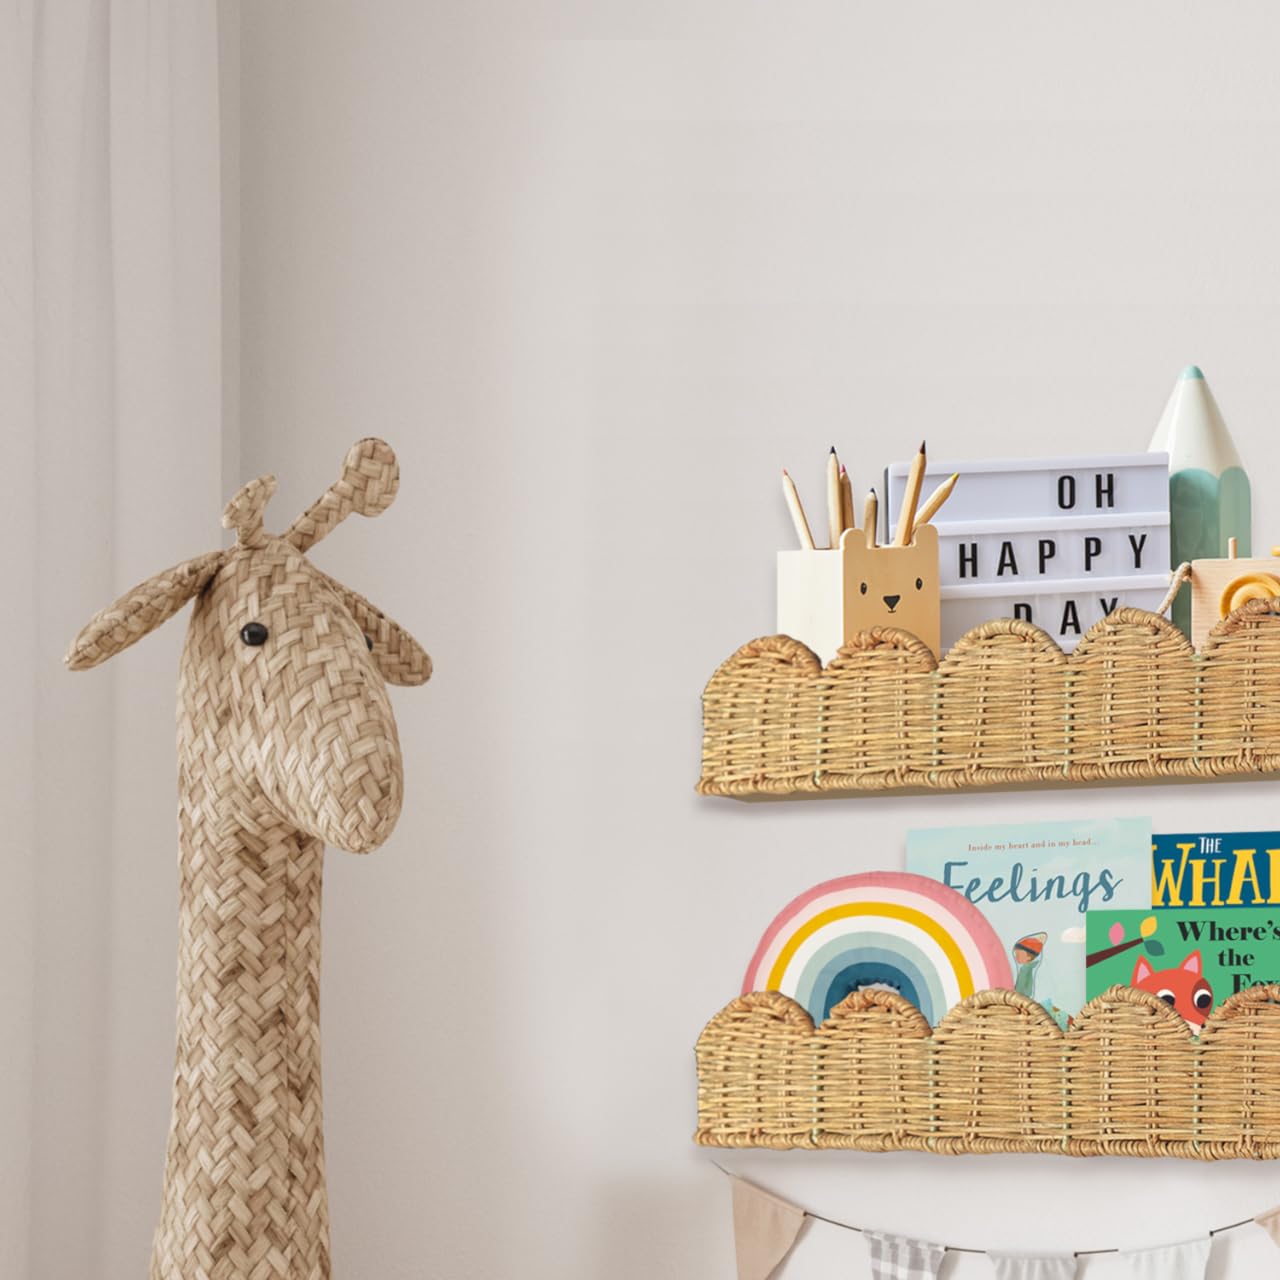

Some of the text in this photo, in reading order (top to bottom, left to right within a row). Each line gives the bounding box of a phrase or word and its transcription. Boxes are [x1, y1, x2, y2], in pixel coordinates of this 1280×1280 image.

[1058, 473, 1115, 509] OH
[958, 534, 1147, 579] HAPPY
[1031, 840, 1046, 849] and
[1048, 839, 1056, 848] in
[1058, 839, 1070, 849] my
[1199, 836, 1222, 854] THE
[944, 861, 1124, 914] Feelings
[1218, 948, 1255, 967] the
